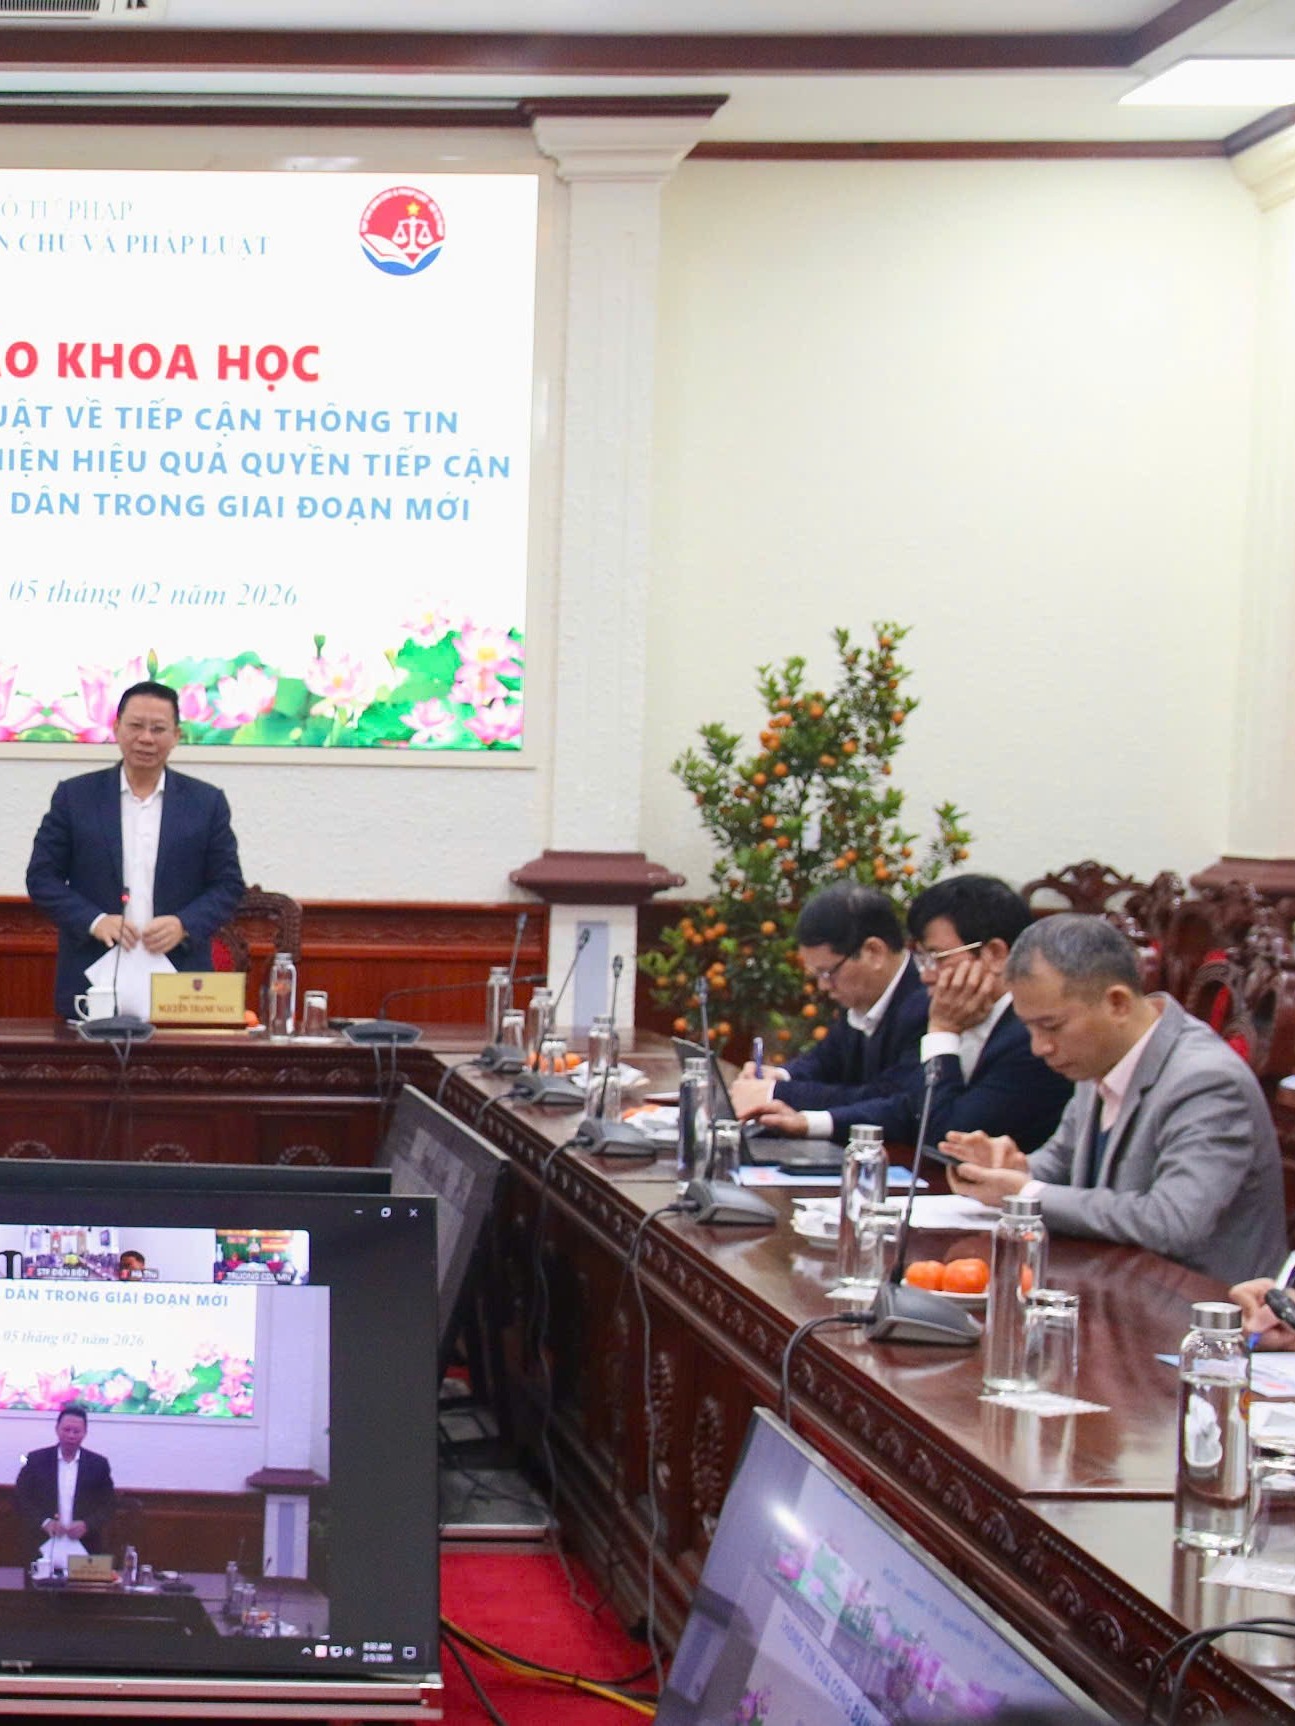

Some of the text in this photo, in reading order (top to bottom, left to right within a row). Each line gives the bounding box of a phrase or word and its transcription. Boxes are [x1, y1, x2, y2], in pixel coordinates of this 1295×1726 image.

[58, 342, 198, 381] KHOA
[218, 344, 319, 391] HỌC
[66, 397, 103, 429] VỀ
[115, 398, 182, 430] TIẾP
[195, 401, 262, 437] CẬN
[274, 402, 391, 433] THÔNG
[404, 411, 458, 434] TIN
[73, 443, 147, 479] HIỆU
[160, 442, 228, 477] QUẢ
[241, 444, 350, 478] QUYỀN
[363, 445, 431, 477] TIẾP
[444, 449, 510, 484] CẬN
[11, 485, 80, 515] DÂN
[94, 493, 205, 517] TRONG
[218, 496, 284, 519] GIAI
[297, 496, 392, 525] ĐOẠN
[406, 491, 469, 521] MỚI
[9, 580, 39, 602] 05
[48, 580, 121, 609] tháng
[132, 582, 162, 605] 02
[171, 584, 226, 605] năm
[238, 583, 298, 607] 2026
[45, 1289, 100, 1303] TRONG
[105, 1292, 137, 1305] GIAI
[143, 1293, 190, 1308] ĐOẠN
